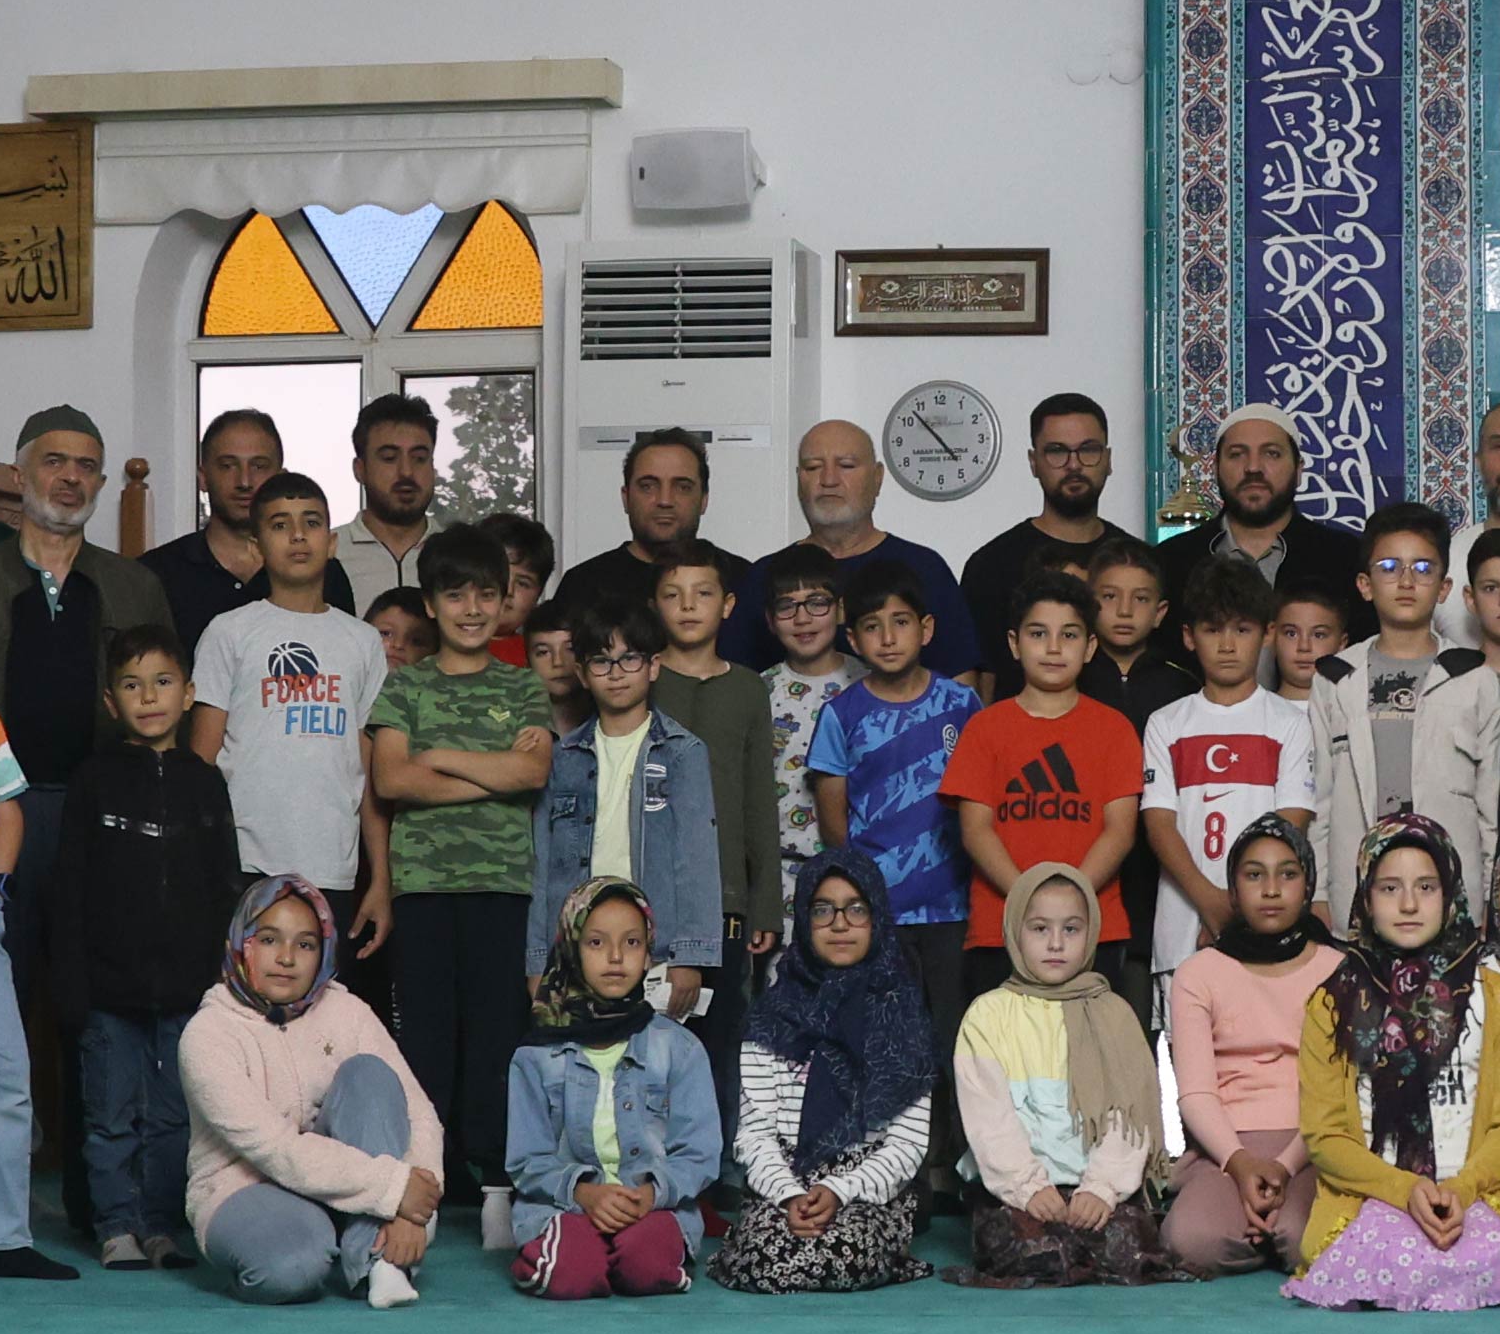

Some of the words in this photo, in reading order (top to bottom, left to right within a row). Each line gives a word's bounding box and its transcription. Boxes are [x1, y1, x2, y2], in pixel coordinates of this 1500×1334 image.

[934, 395, 946, 405] 12
[958, 400, 964, 409] 1
[915, 401, 925, 411] 11
[902, 416, 914, 427] 10
[972, 414, 978, 424] 2
[896, 437, 903, 447] 9
[978, 433, 984, 443] 3
[903, 457, 910, 467] 8
[972, 455, 978, 464] 4
[918, 470, 924, 480] 7
[958, 469, 964, 479] 5
[938, 475, 944, 485] 6
[261, 672, 342, 708] FORCE
[285, 705, 347, 737] FIELD
[997, 791, 1092, 825] adidas
[1203, 811, 1224, 861] 8
